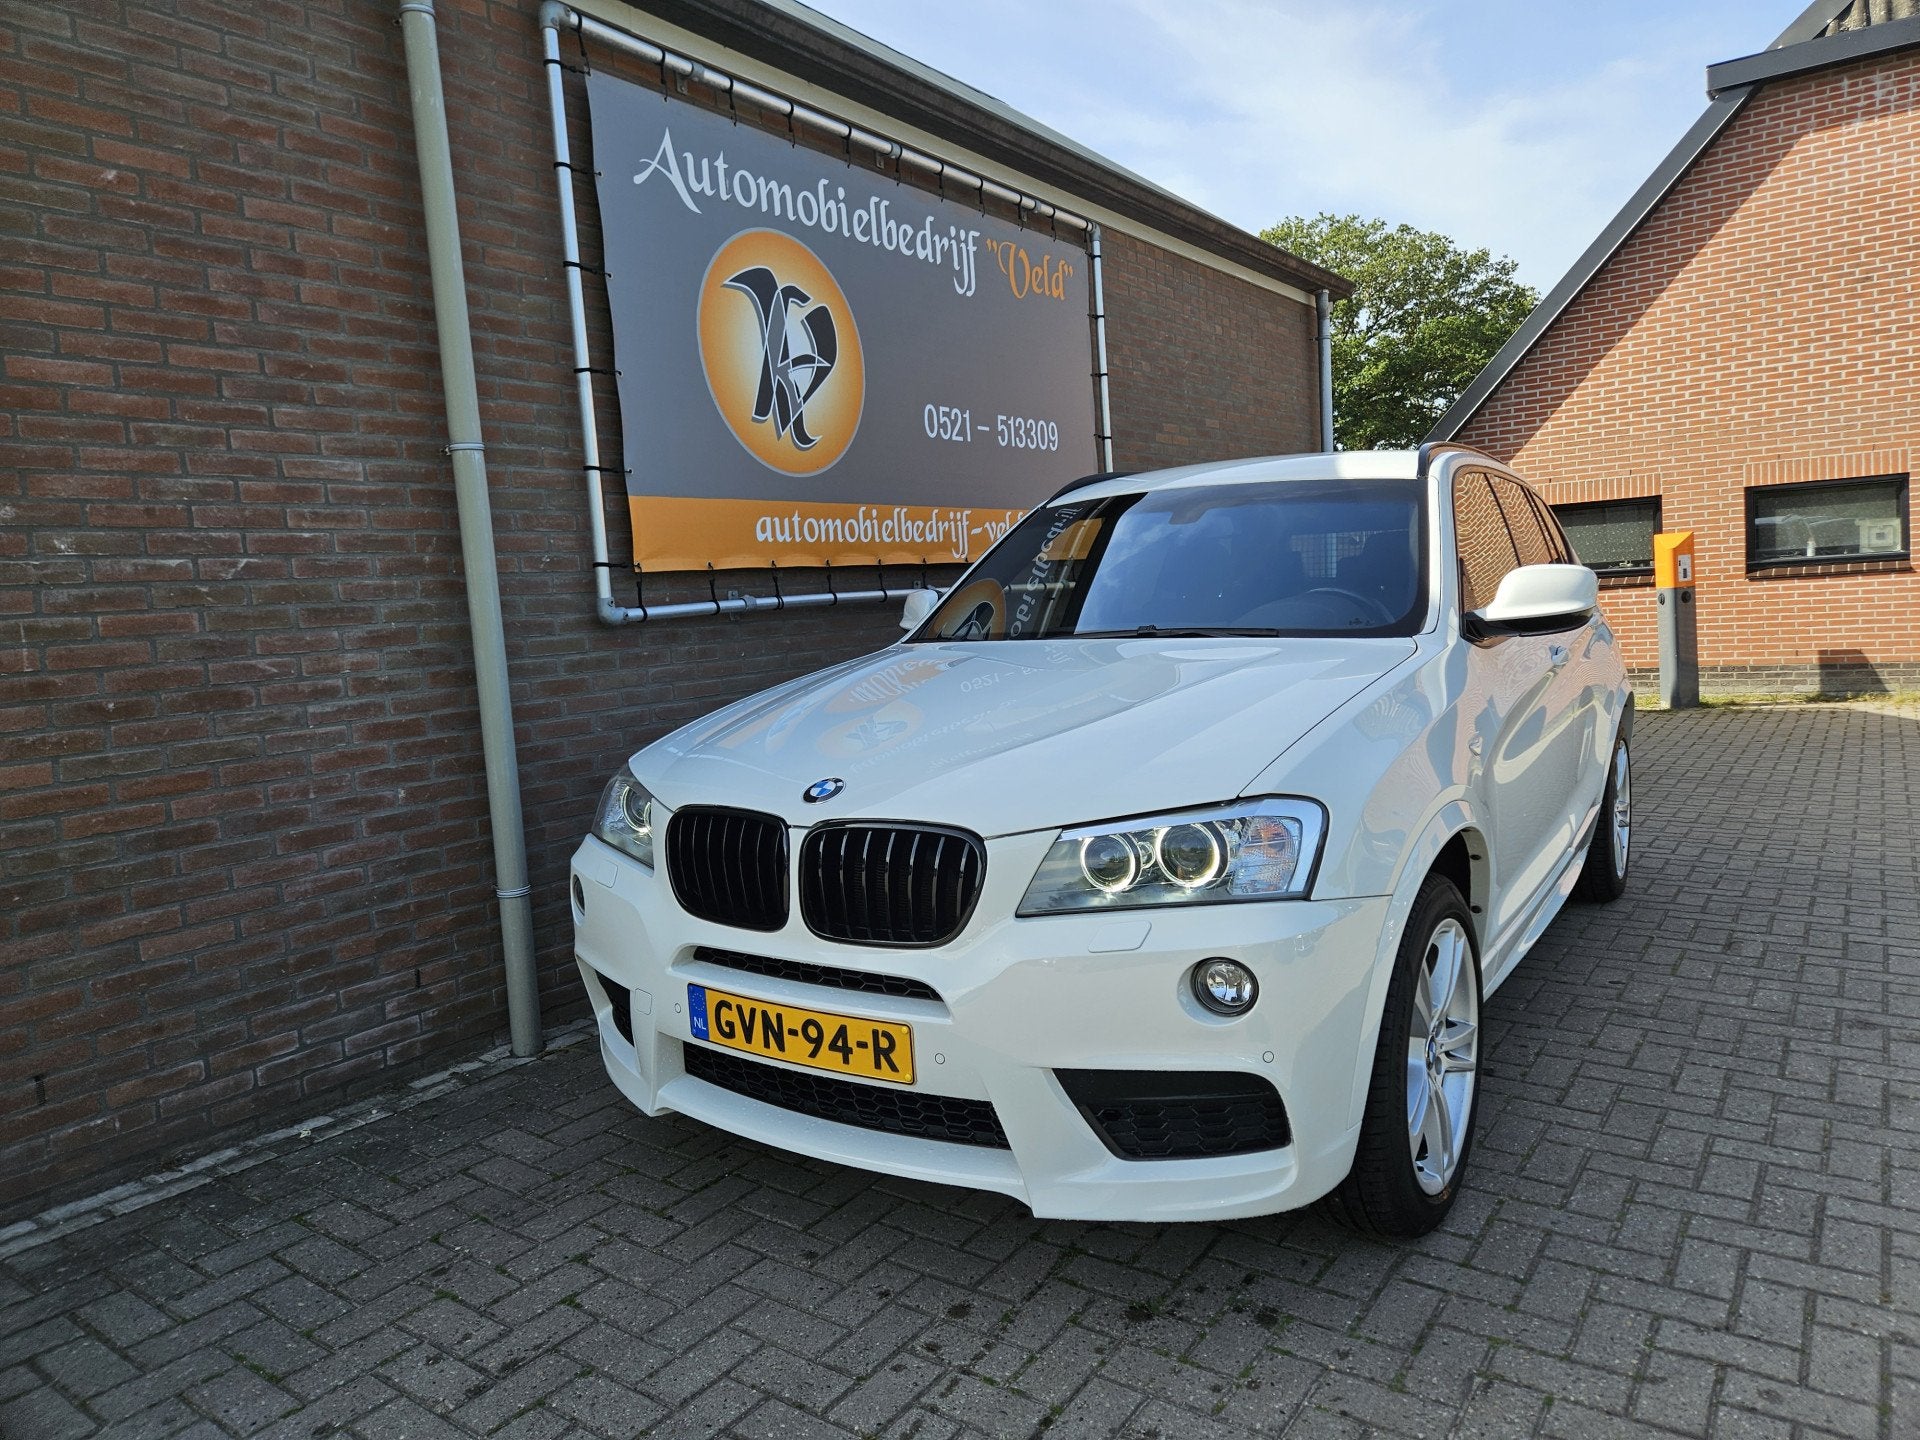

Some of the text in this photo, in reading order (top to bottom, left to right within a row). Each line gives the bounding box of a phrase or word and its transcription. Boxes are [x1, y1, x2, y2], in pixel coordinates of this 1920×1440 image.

[633, 127, 979, 297] Automobielbedrijf
[924, 404, 972, 442] 0521
[997, 415, 1059, 451] 513309
[693, 999, 900, 1073] NL GVN-94-R
